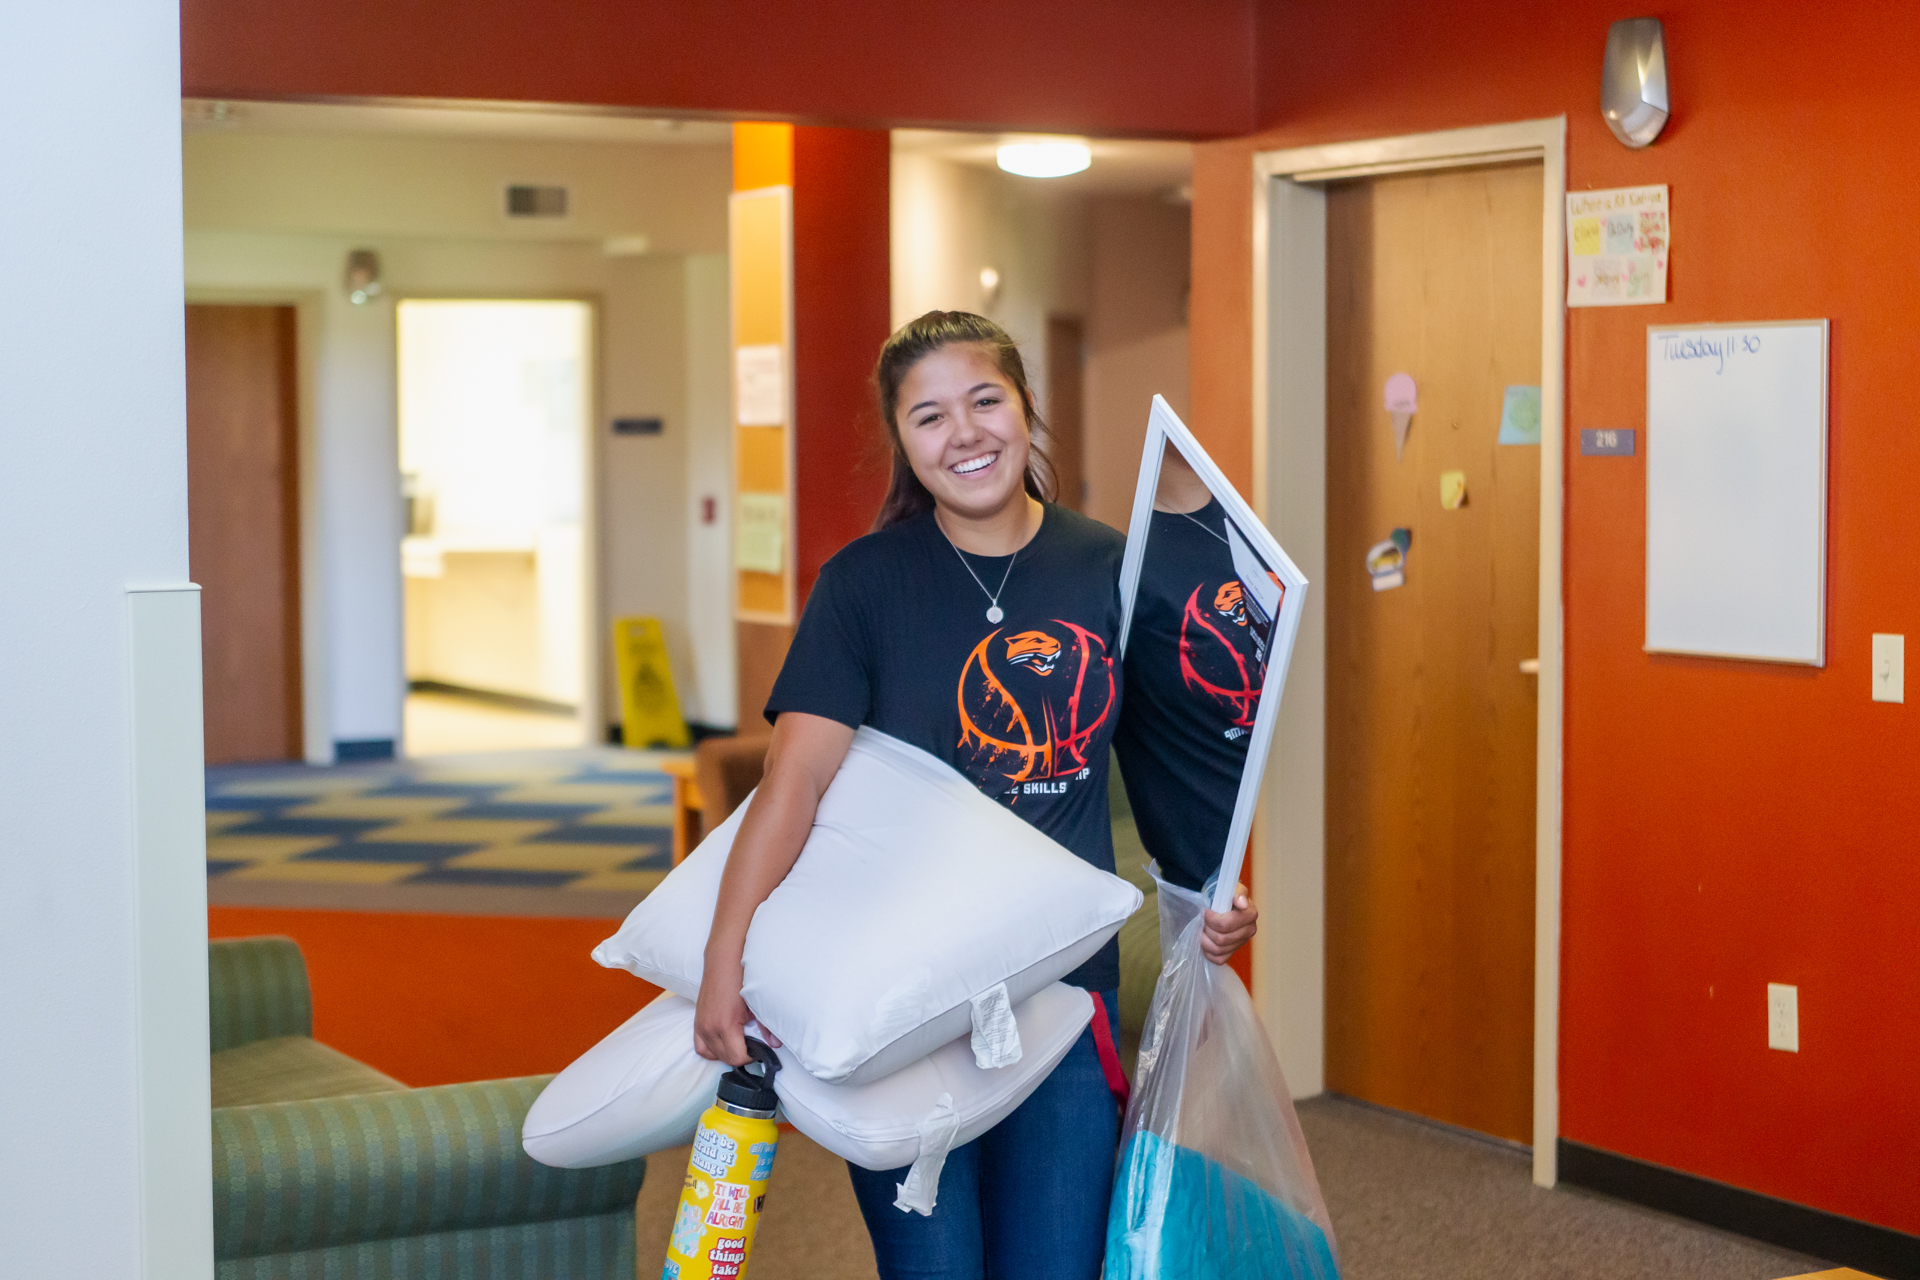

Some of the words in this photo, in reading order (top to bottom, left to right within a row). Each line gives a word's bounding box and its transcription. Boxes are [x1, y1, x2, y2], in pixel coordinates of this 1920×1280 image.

[1657, 332, 1724, 375] Tuesday
[1023, 782, 1067, 794] SKILLS
[720, 1136, 735, 1150] be
[720, 1152, 735, 1165] of
[714, 1183, 727, 1196] IT
[728, 1186, 748, 1200] WILL
[713, 1198, 731, 1212] ALL
[733, 1201, 744, 1214] BE
[706, 1211, 745, 1229] ALRIGHT
[717, 1237, 746, 1250] good
[709, 1249, 745, 1265] things
[712, 1264, 739, 1275] take
